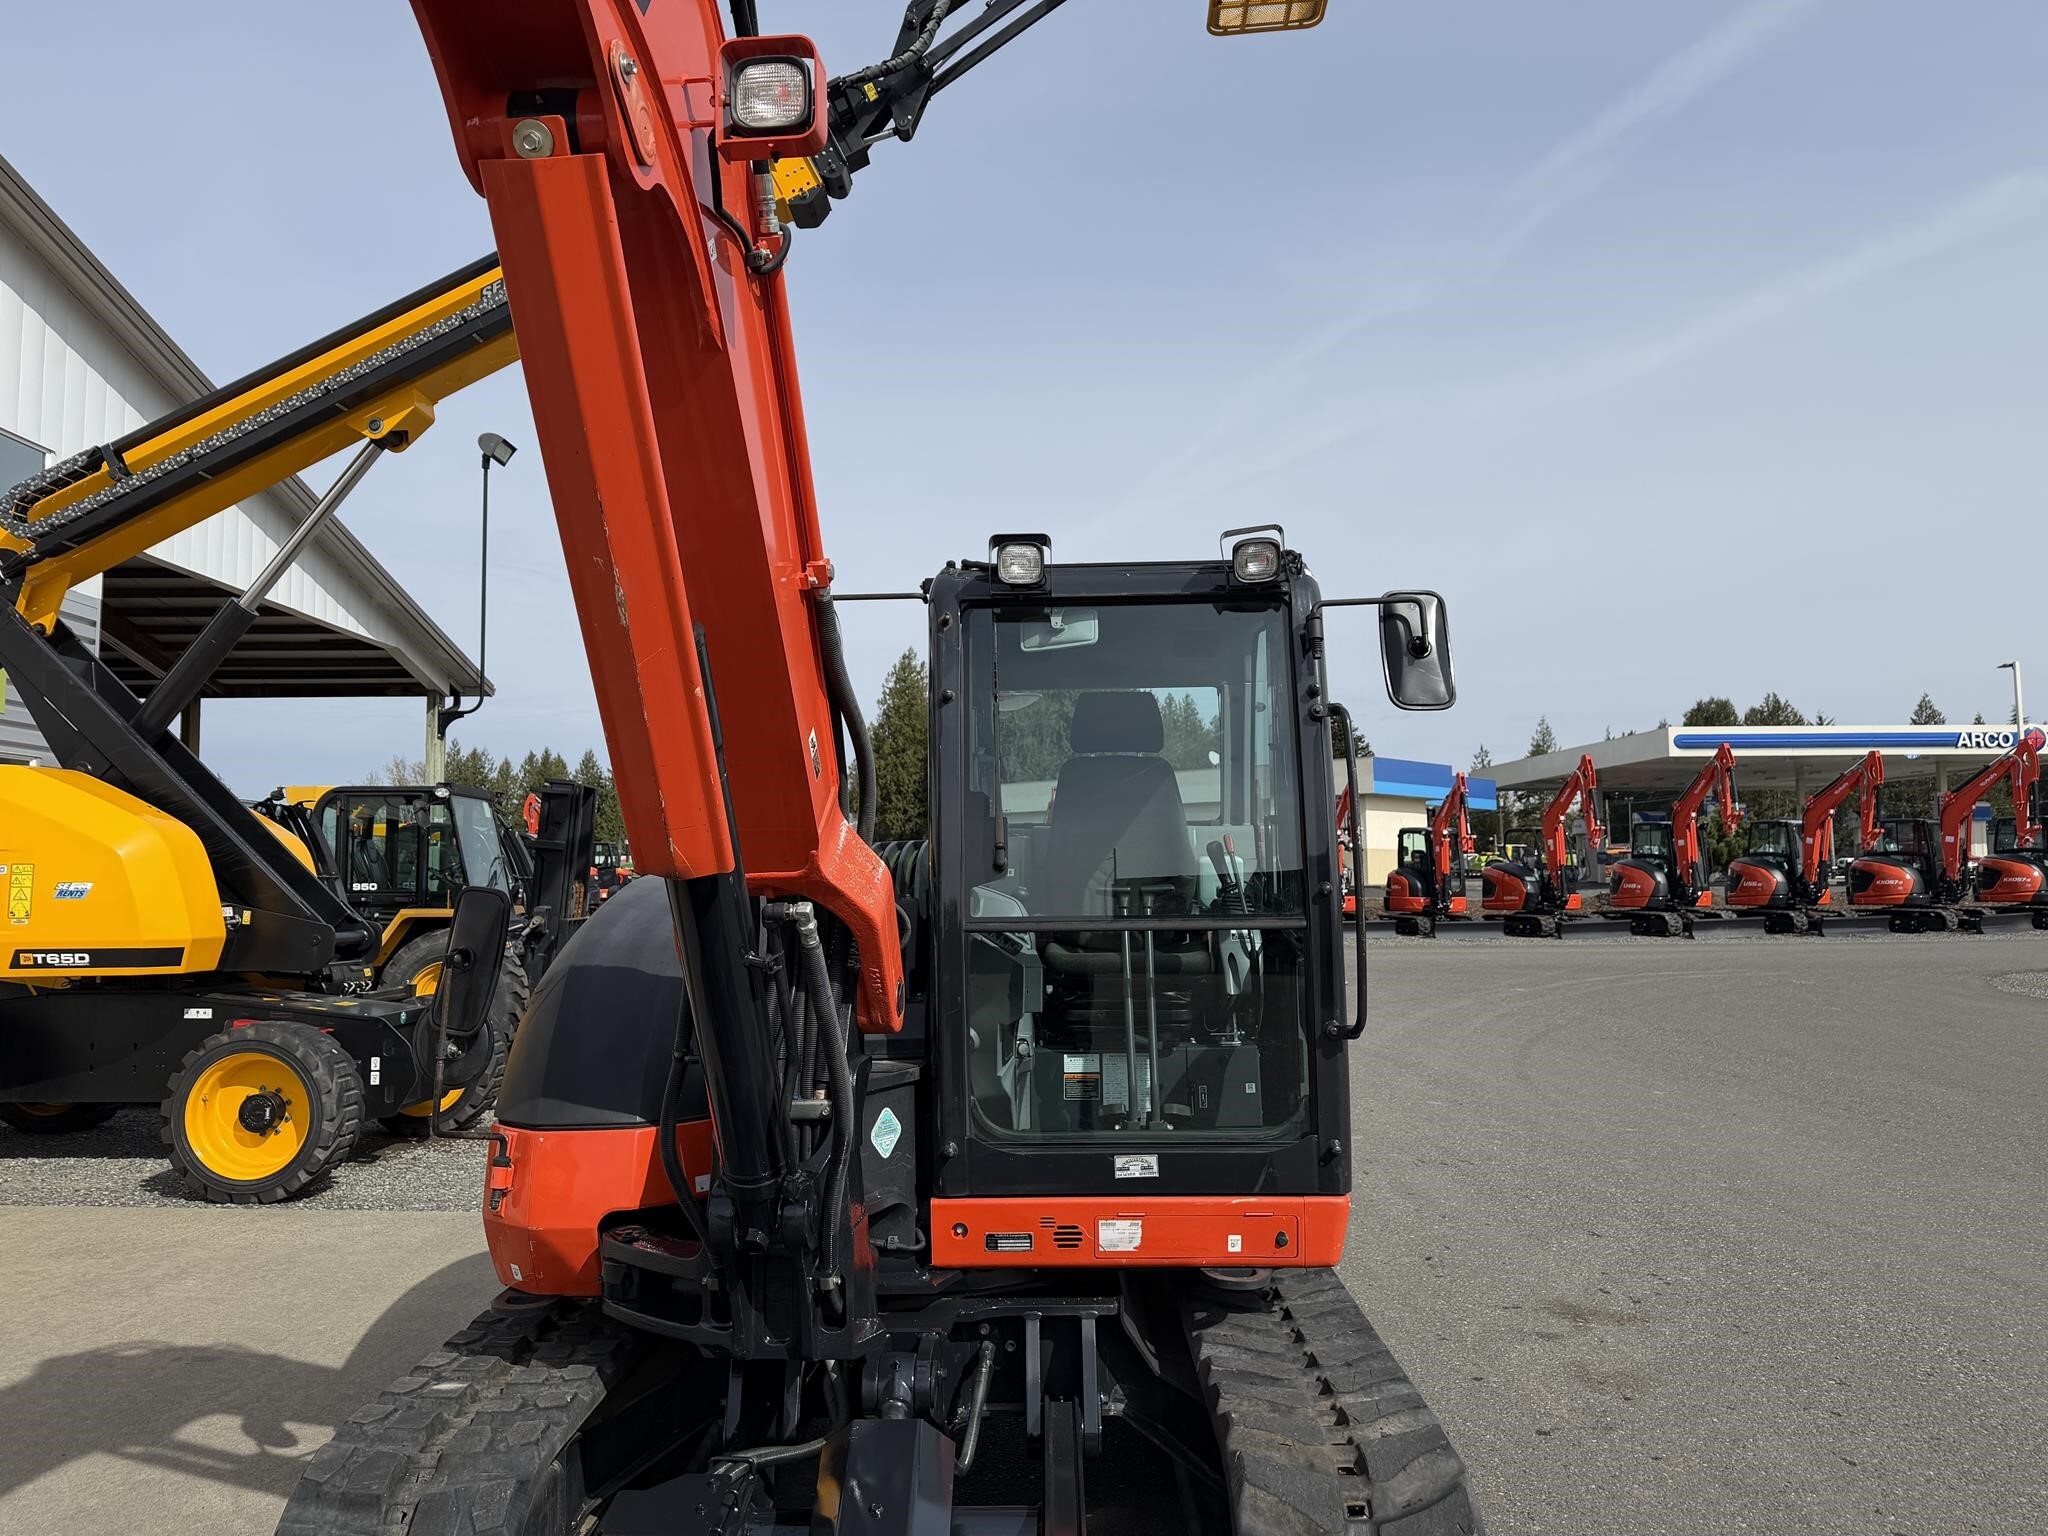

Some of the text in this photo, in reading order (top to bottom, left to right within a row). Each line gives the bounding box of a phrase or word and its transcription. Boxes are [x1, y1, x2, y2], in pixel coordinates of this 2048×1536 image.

[1957, 732, 2014, 748] ARCO
[352, 882, 378, 891] 950
[56, 889, 85, 898] RENTS
[32, 953, 90, 965] T65D
